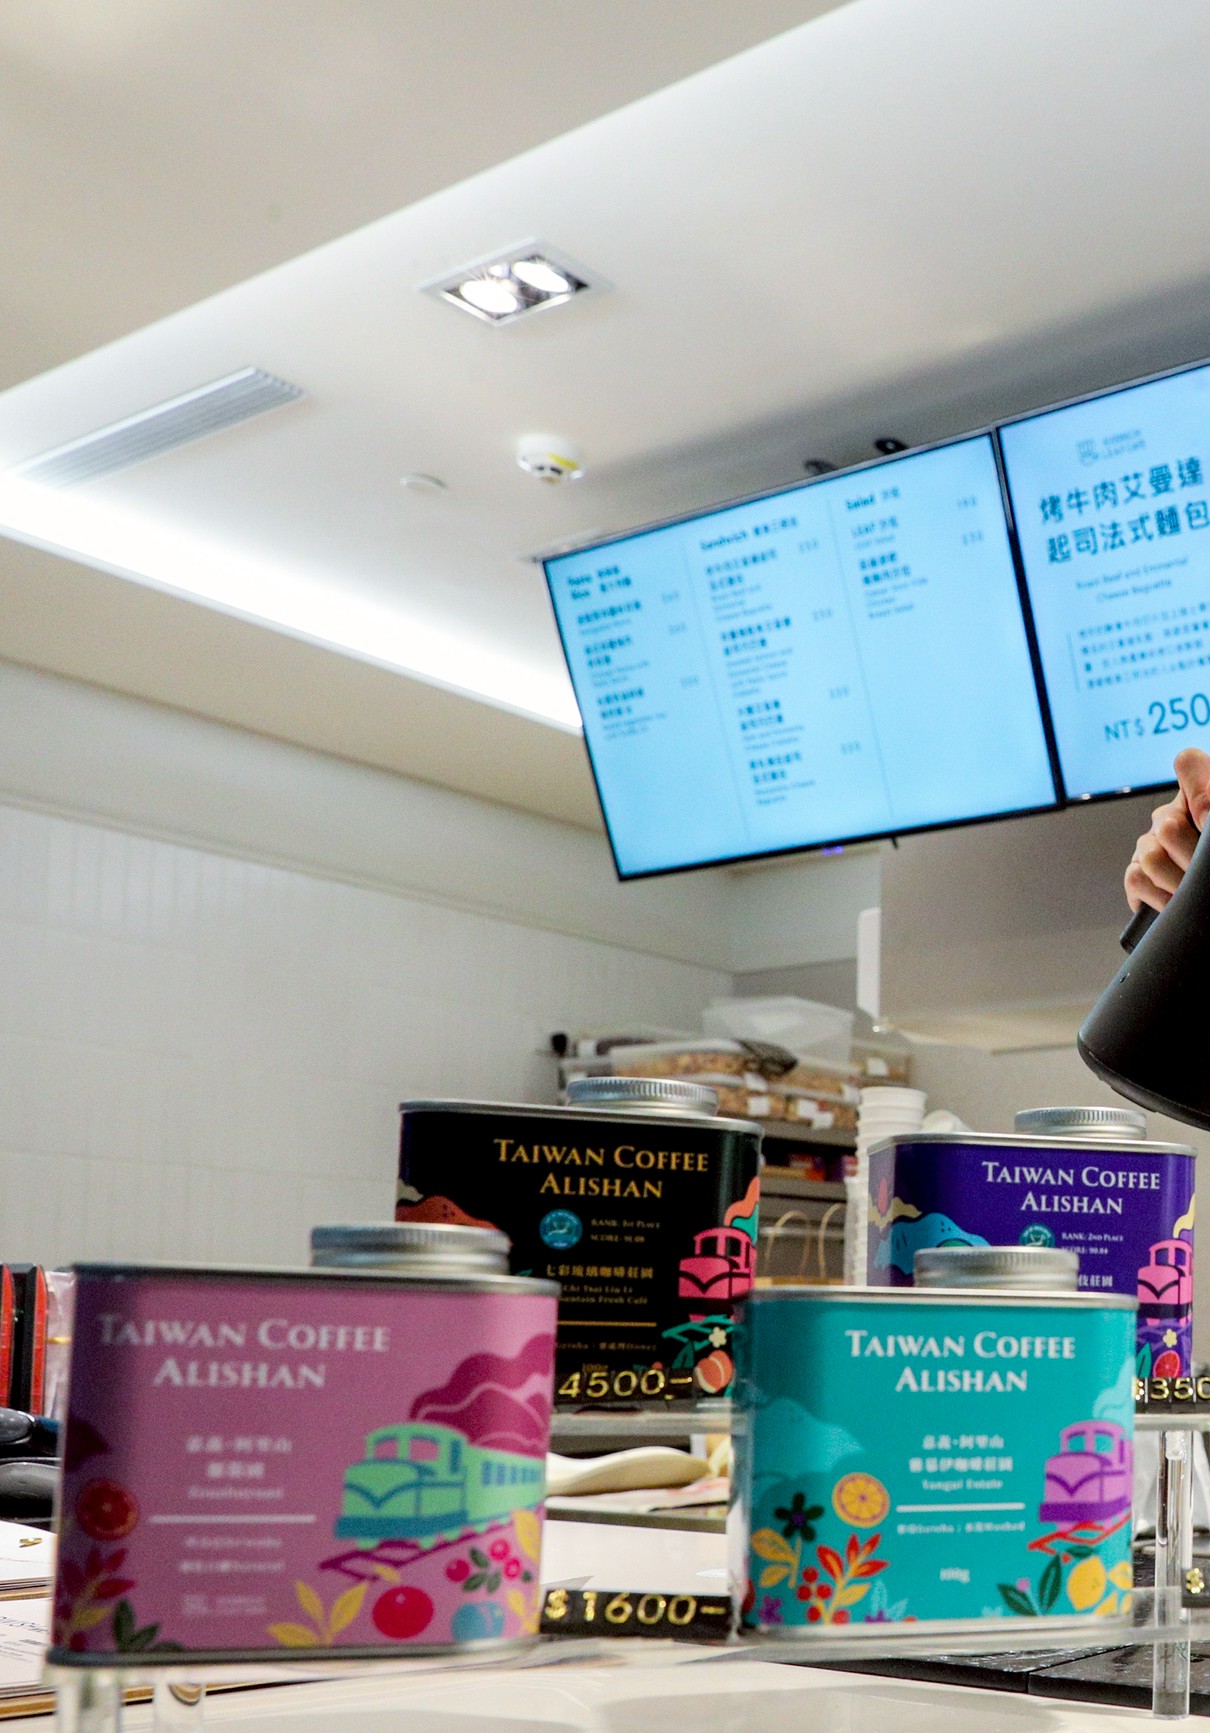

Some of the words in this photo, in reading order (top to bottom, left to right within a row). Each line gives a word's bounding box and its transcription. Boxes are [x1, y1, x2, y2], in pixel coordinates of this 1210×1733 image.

[1047, 500, 1210, 564] 起司法式麵包
[1149, 693, 1210, 735] 250
[493, 1138, 605, 1166] TAIWAN
[614, 1145, 709, 1172] COFFEE
[539, 1173, 663, 1199] ALISHAN
[981, 1161, 1074, 1186] TAIWAN
[1081, 1166, 1161, 1191] COFFEE
[1021, 1191, 1123, 1215] ALISHAN
[100, 1314, 246, 1349] TAIWAN
[257, 1318, 390, 1352] COFFEE
[845, 1330, 965, 1358] TAIWAN
[973, 1331, 1076, 1360] COFFEE
[152, 1357, 326, 1388] ALISHAN
[895, 1366, 1028, 1393] ALISHAN
